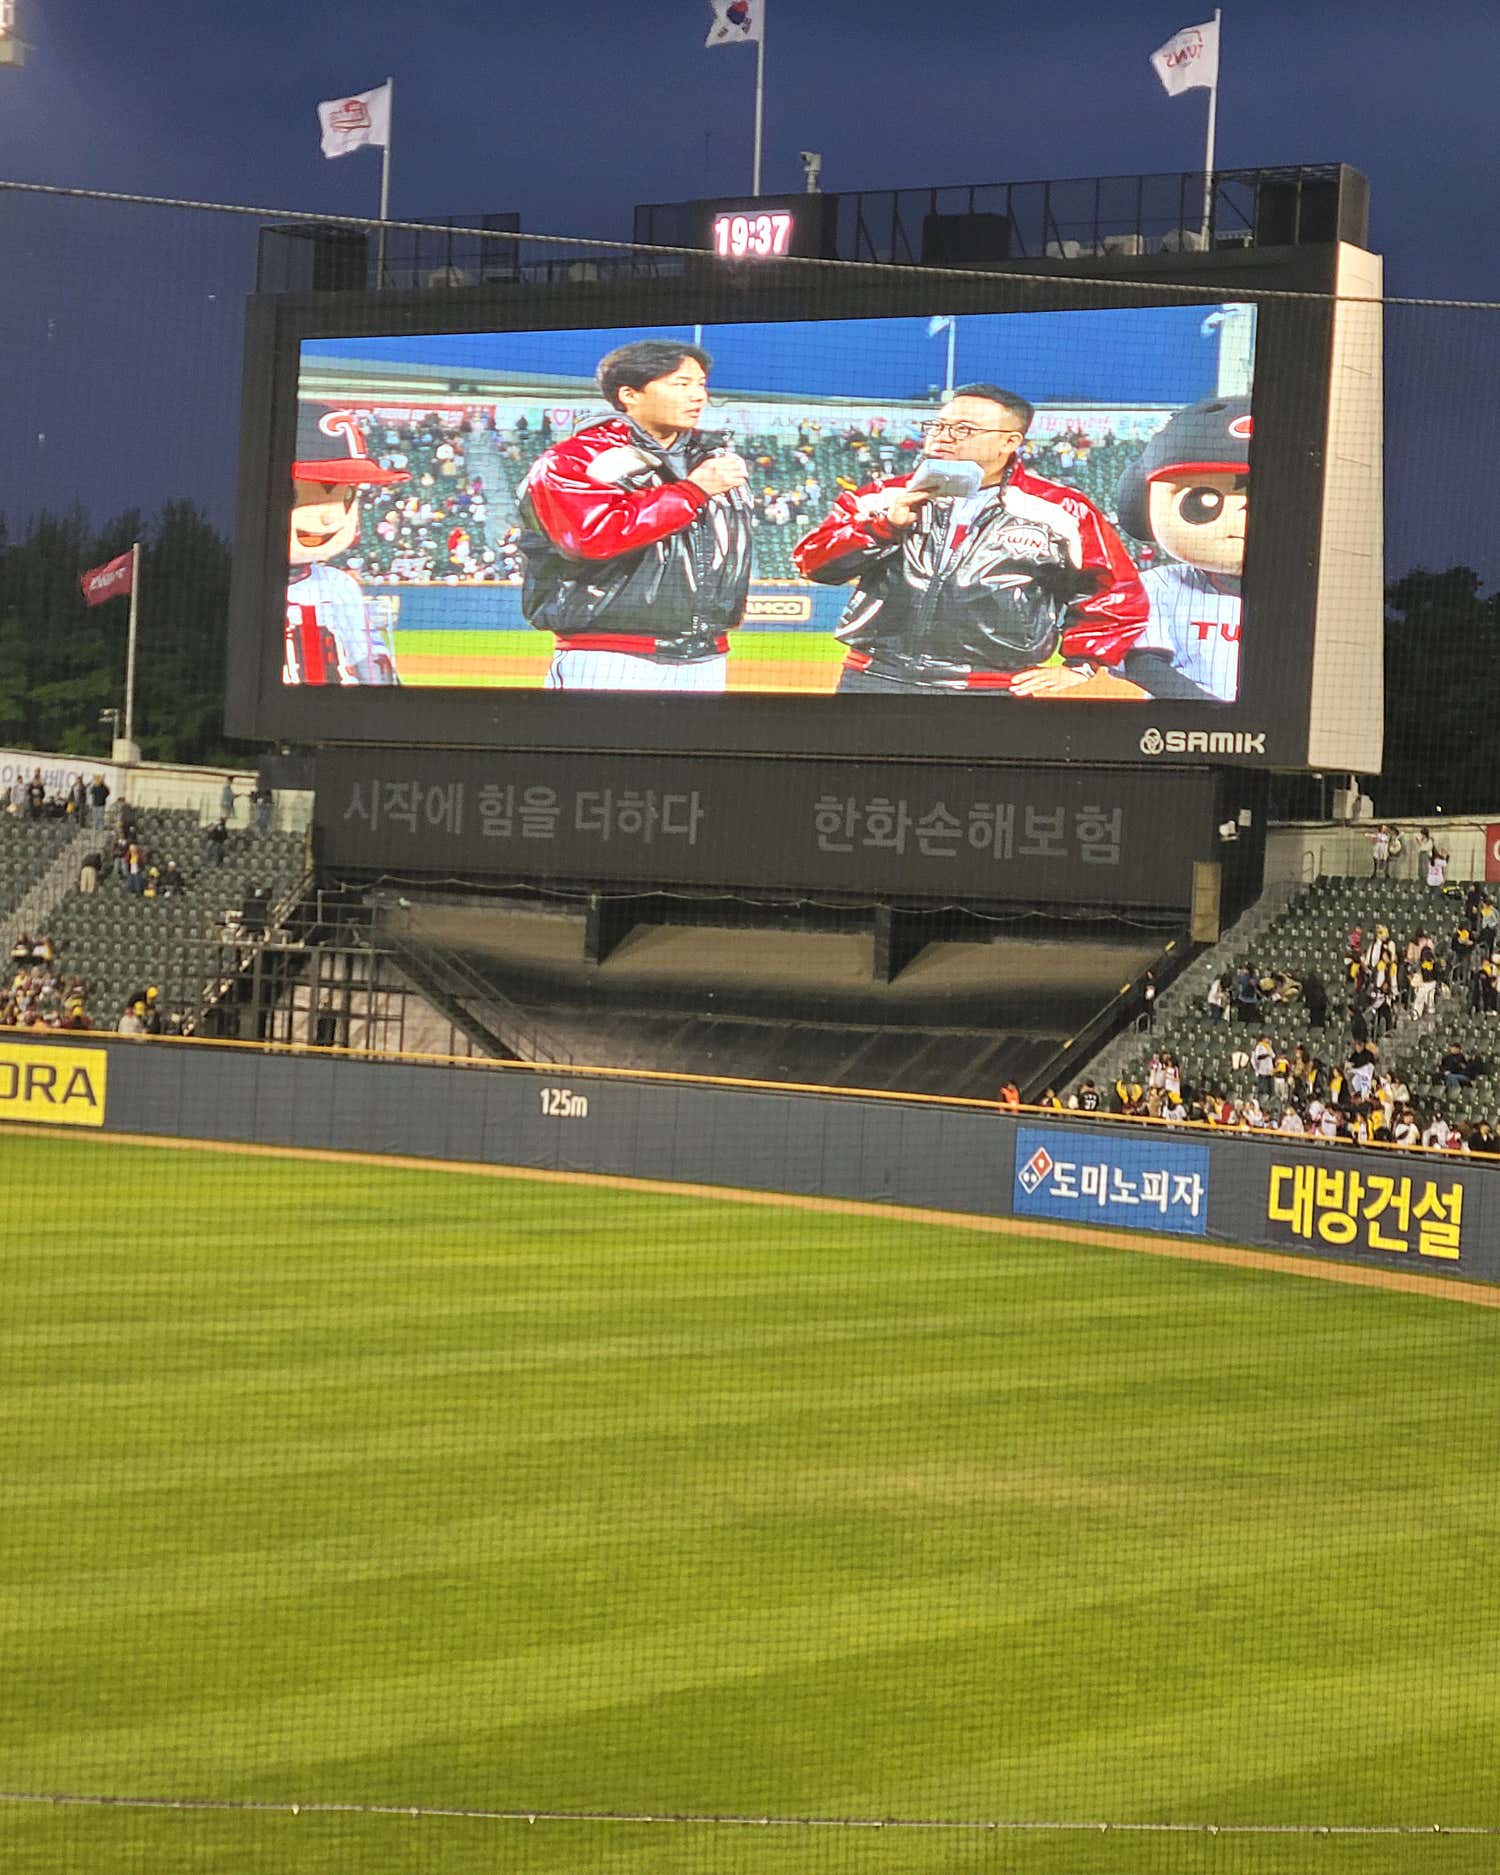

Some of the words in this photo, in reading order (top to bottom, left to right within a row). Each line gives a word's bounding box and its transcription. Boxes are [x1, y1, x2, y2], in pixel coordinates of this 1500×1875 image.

[714, 214, 792, 256] 19:37
[1165, 730, 1267, 754] SAMIK
[343, 779, 464, 835] 시작에
[478, 783, 561, 839] 힘을
[575, 788, 705, 846] 더하다
[813, 795, 1124, 865] 한화손해보험
[540, 1087, 588, 1117] 125m
[1049, 1160, 1205, 1217] 도미노피자
[1268, 1164, 1464, 1261] 대방건설
